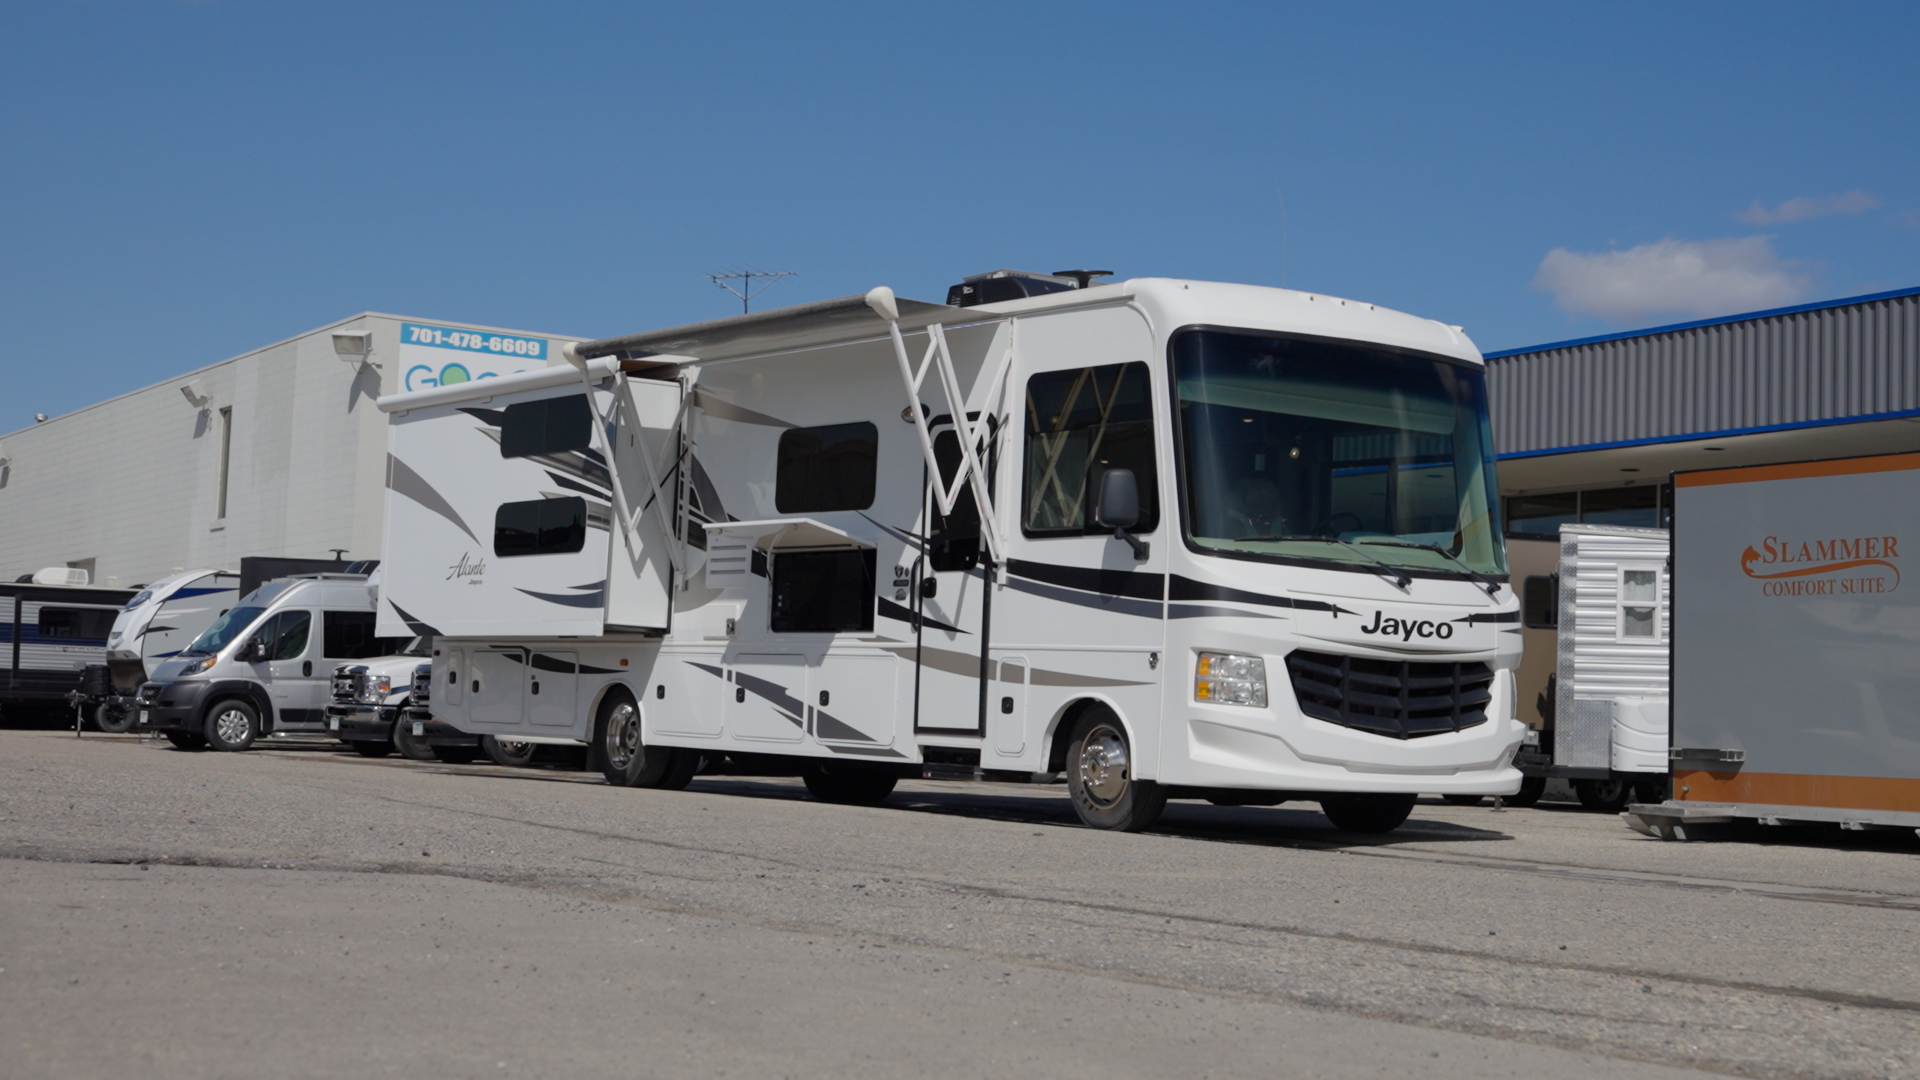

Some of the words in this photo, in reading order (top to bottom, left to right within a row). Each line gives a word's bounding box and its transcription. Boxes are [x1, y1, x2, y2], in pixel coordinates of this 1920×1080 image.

[409, 326, 540, 356] 701-478-6609
[1762, 536, 1899, 564] SLAMMER
[446, 551, 486, 580] Alante
[1763, 579, 1836, 597] COMFORT
[1840, 577, 1885, 594] SUITE
[1361, 610, 1453, 642] Jayco
